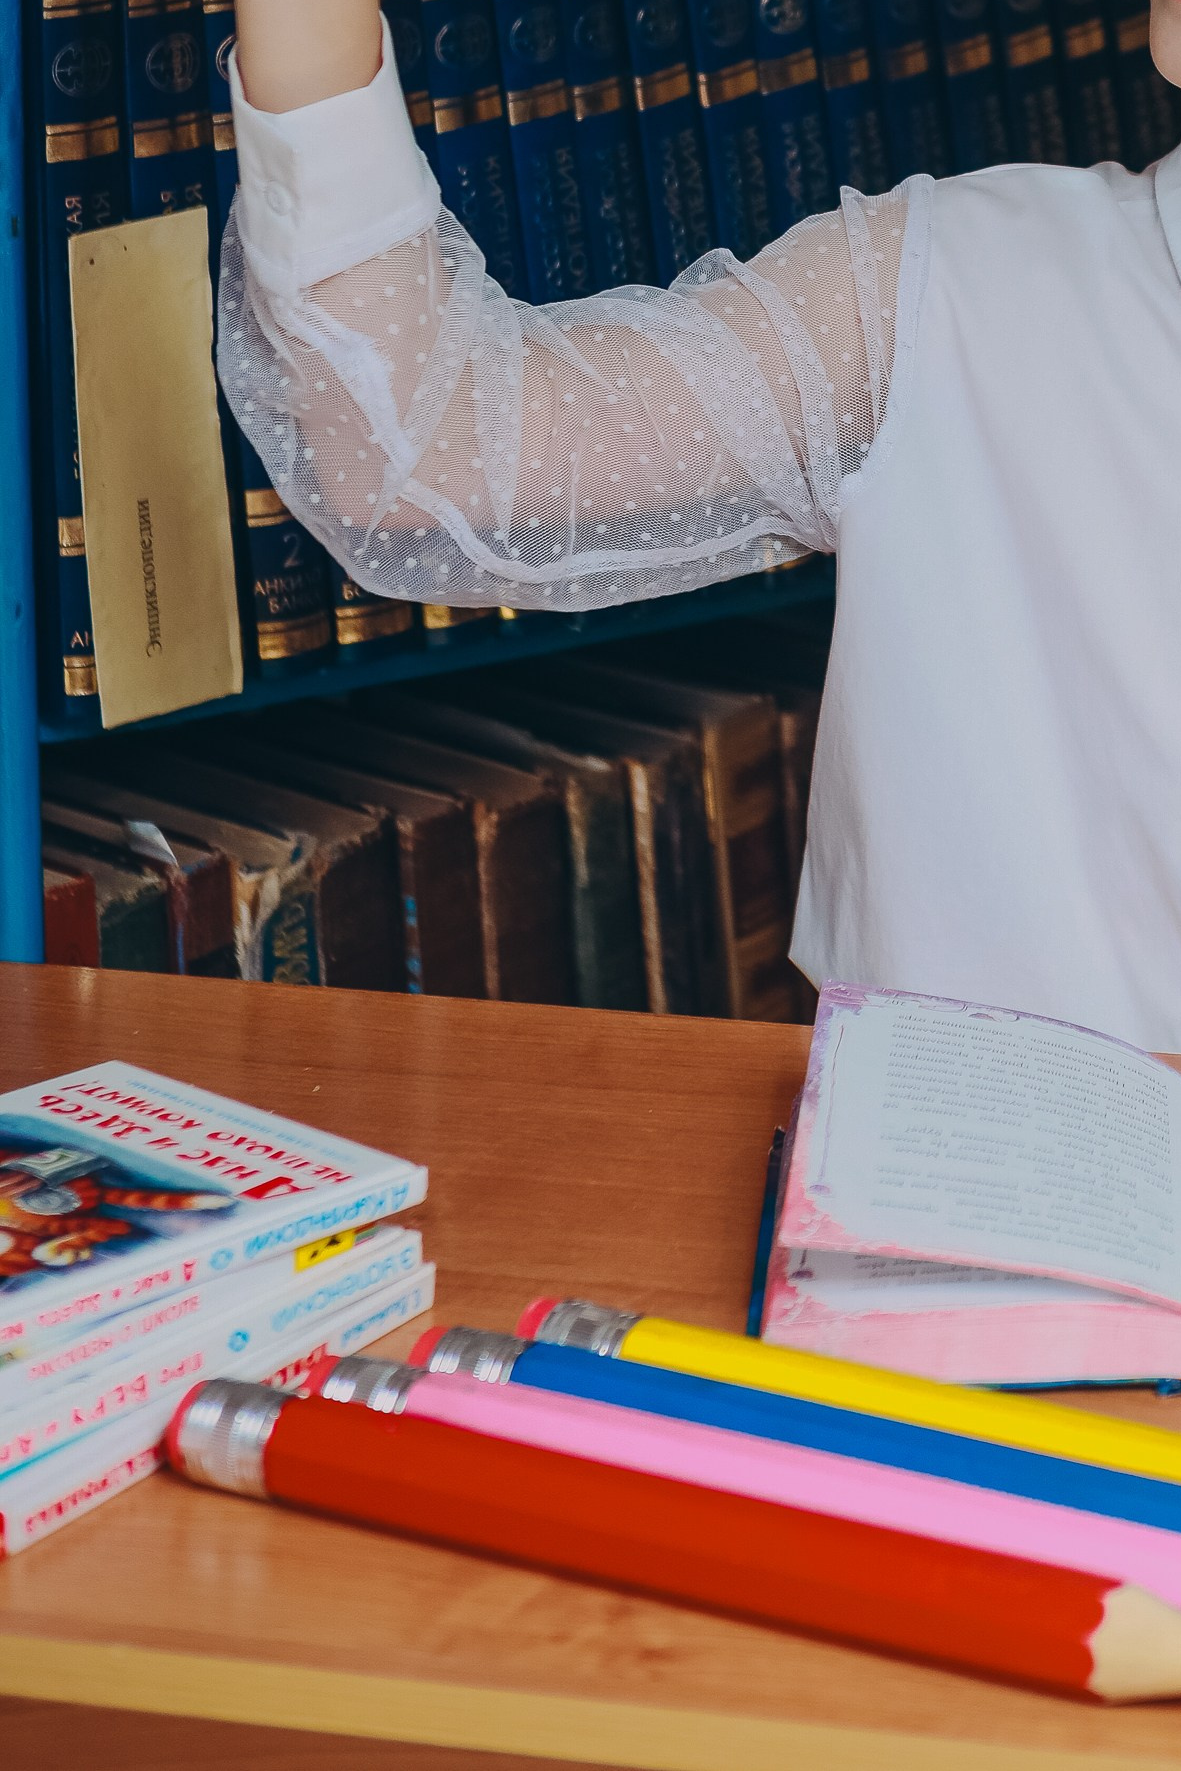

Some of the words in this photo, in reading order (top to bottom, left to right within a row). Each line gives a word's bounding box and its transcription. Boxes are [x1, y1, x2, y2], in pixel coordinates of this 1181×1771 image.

[283, 533, 304, 568] 2
[137, 499, 163, 658] Энциклопедии
[38, 1093, 152, 1141] ЗДЕСЬ
[58, 1079, 203, 1131] КОРМЯТ!
[145, 1135, 180, 1153] И
[175, 1148, 261, 1182] НАС
[204, 1129, 355, 1186] НЕПЛОХО
